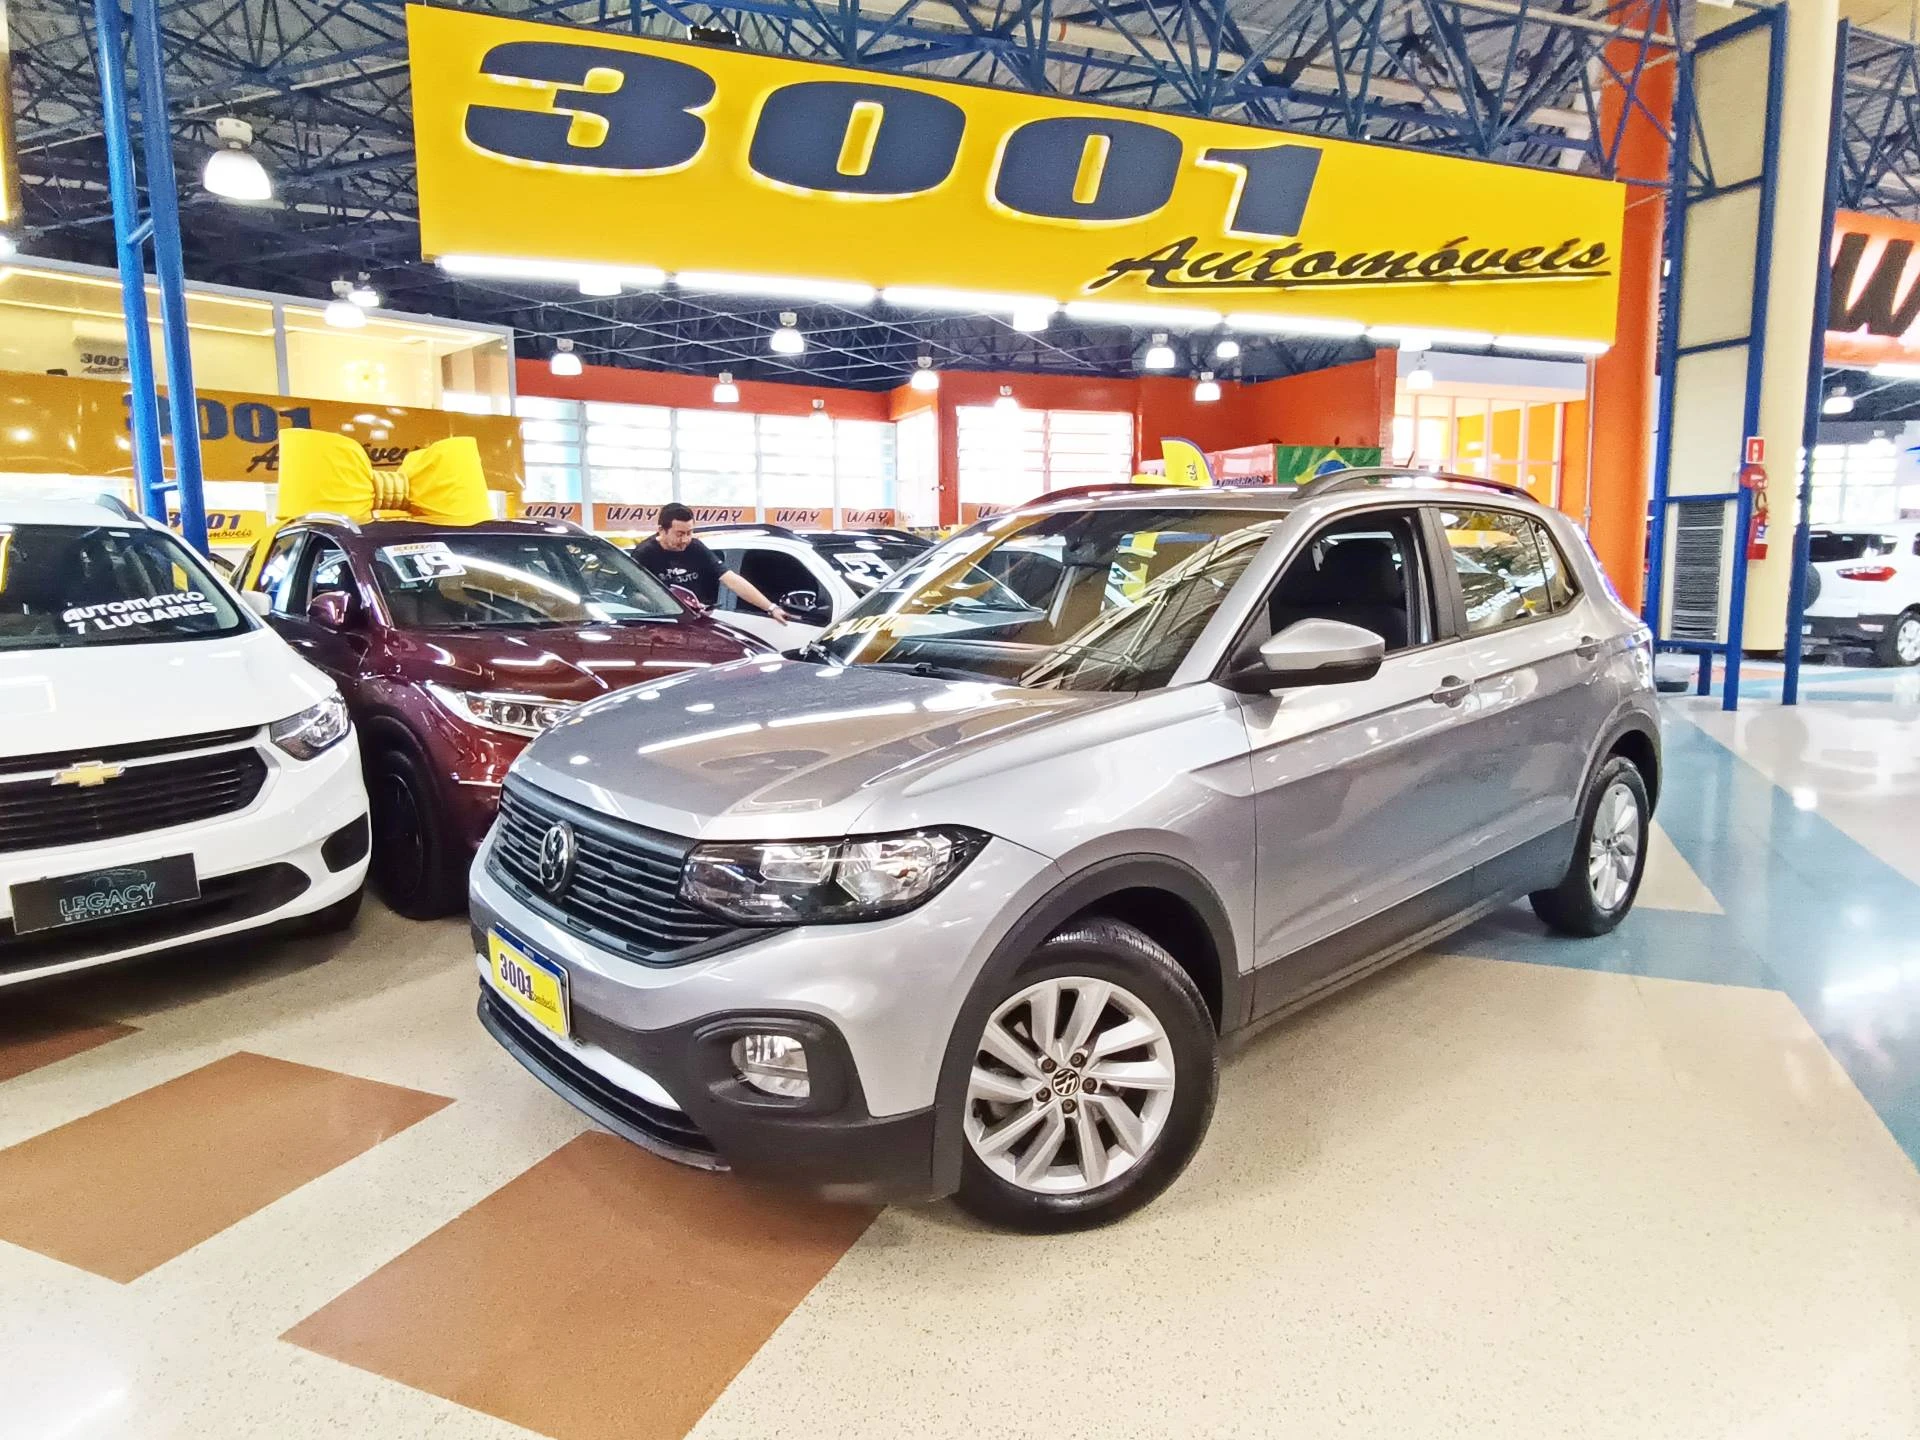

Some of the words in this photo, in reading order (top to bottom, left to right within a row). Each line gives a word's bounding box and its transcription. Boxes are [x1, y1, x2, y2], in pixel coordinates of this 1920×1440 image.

[465, 41, 1324, 238] 3001
[1087, 235, 1613, 291] Automóveis
[168, 511, 241, 530] 301
[607, 505, 659, 521] WAY
[695, 508, 743, 522] WAY
[776, 509, 821, 523] WAY
[847, 511, 889, 523] WAY
[68, 621, 86, 635] 7
[94, 601, 218, 631] LUGARES
[60, 881, 156, 917] LEGACY
